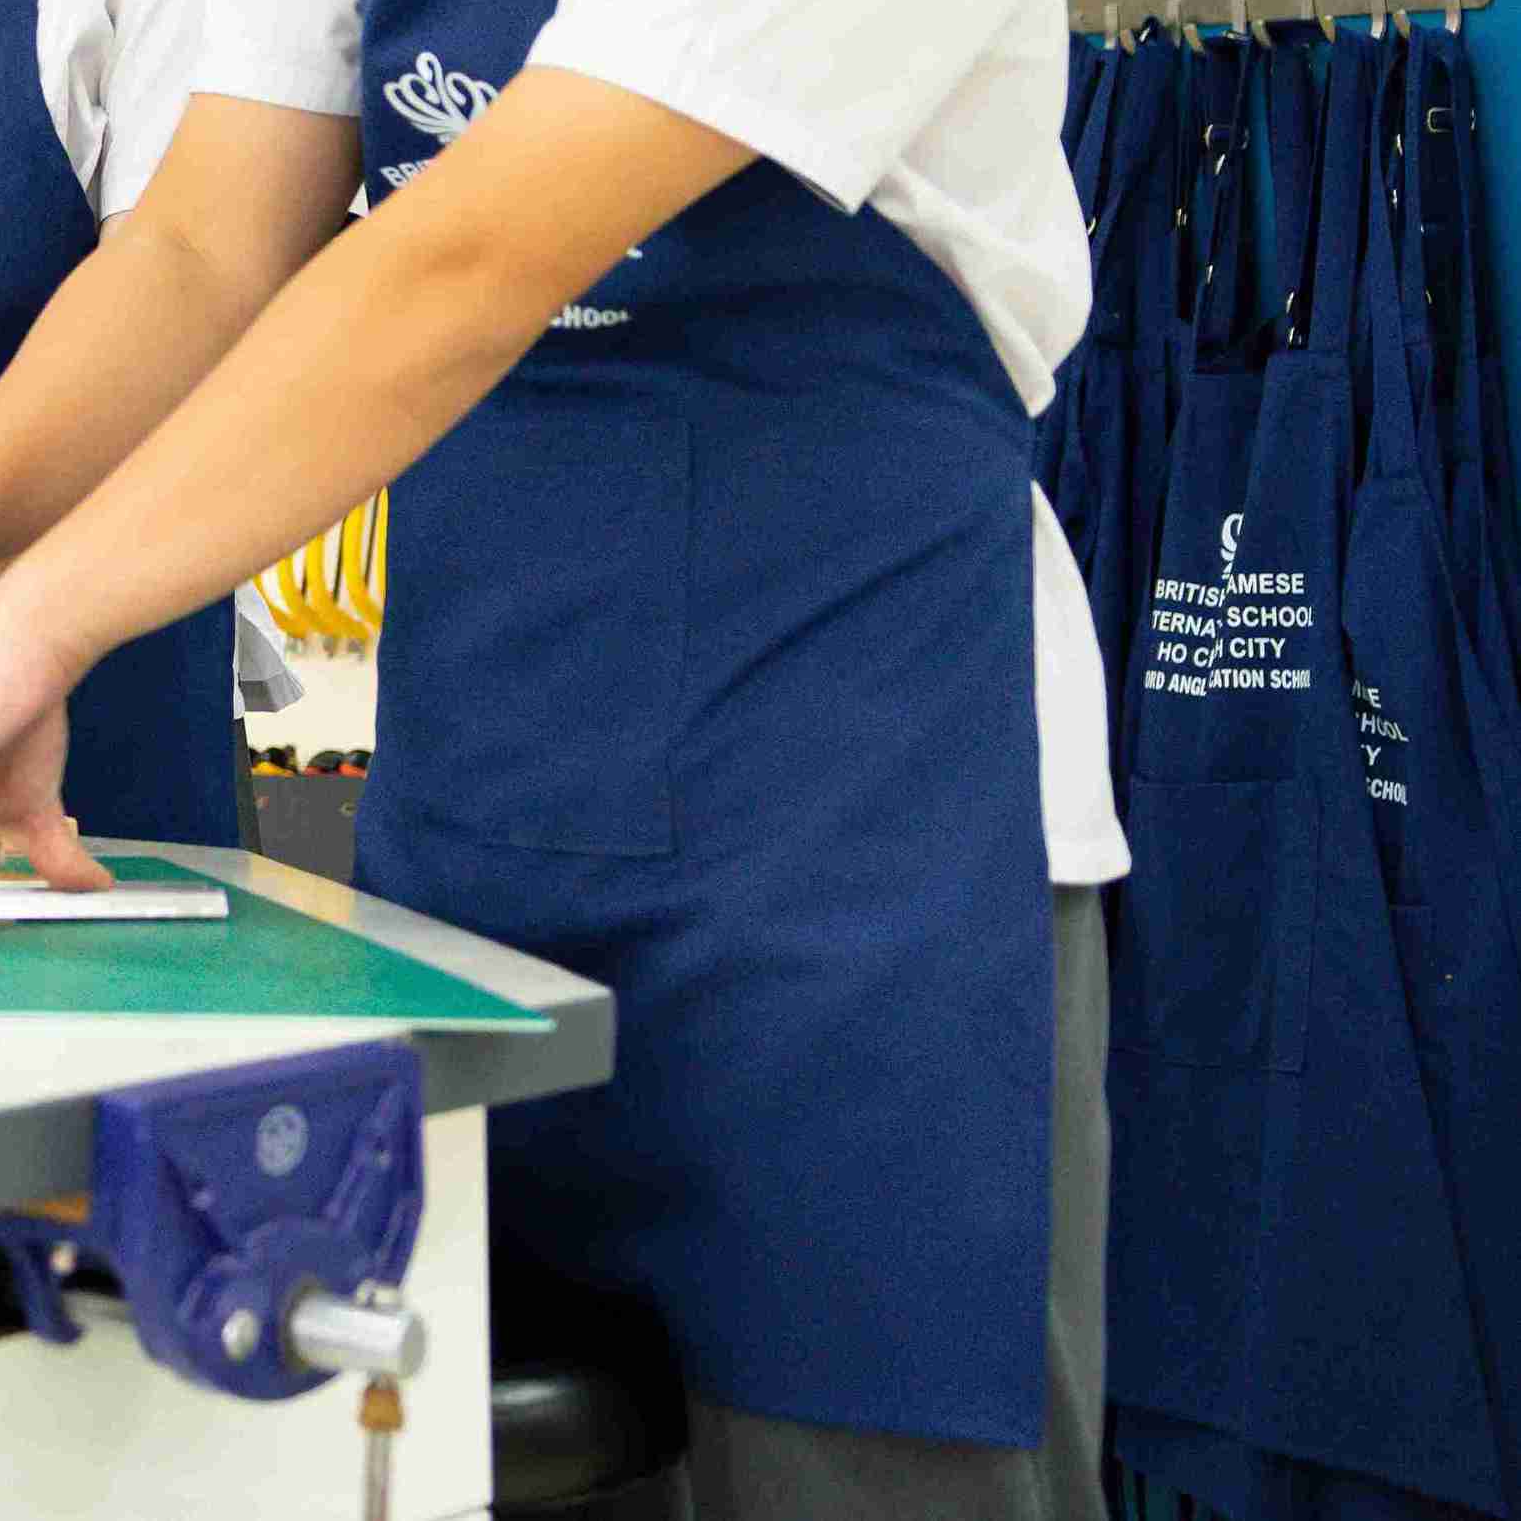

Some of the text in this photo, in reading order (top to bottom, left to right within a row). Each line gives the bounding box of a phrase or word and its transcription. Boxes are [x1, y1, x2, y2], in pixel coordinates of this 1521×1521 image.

[1226, 572, 1305, 595] AMESE
[1226, 605, 1314, 628] SCHOOL
[1157, 640, 1188, 664] HO
[1229, 637, 1286, 659] CITY
[1144, 669, 1166, 690] ORD
[1168, 673, 1207, 697] ANGL
